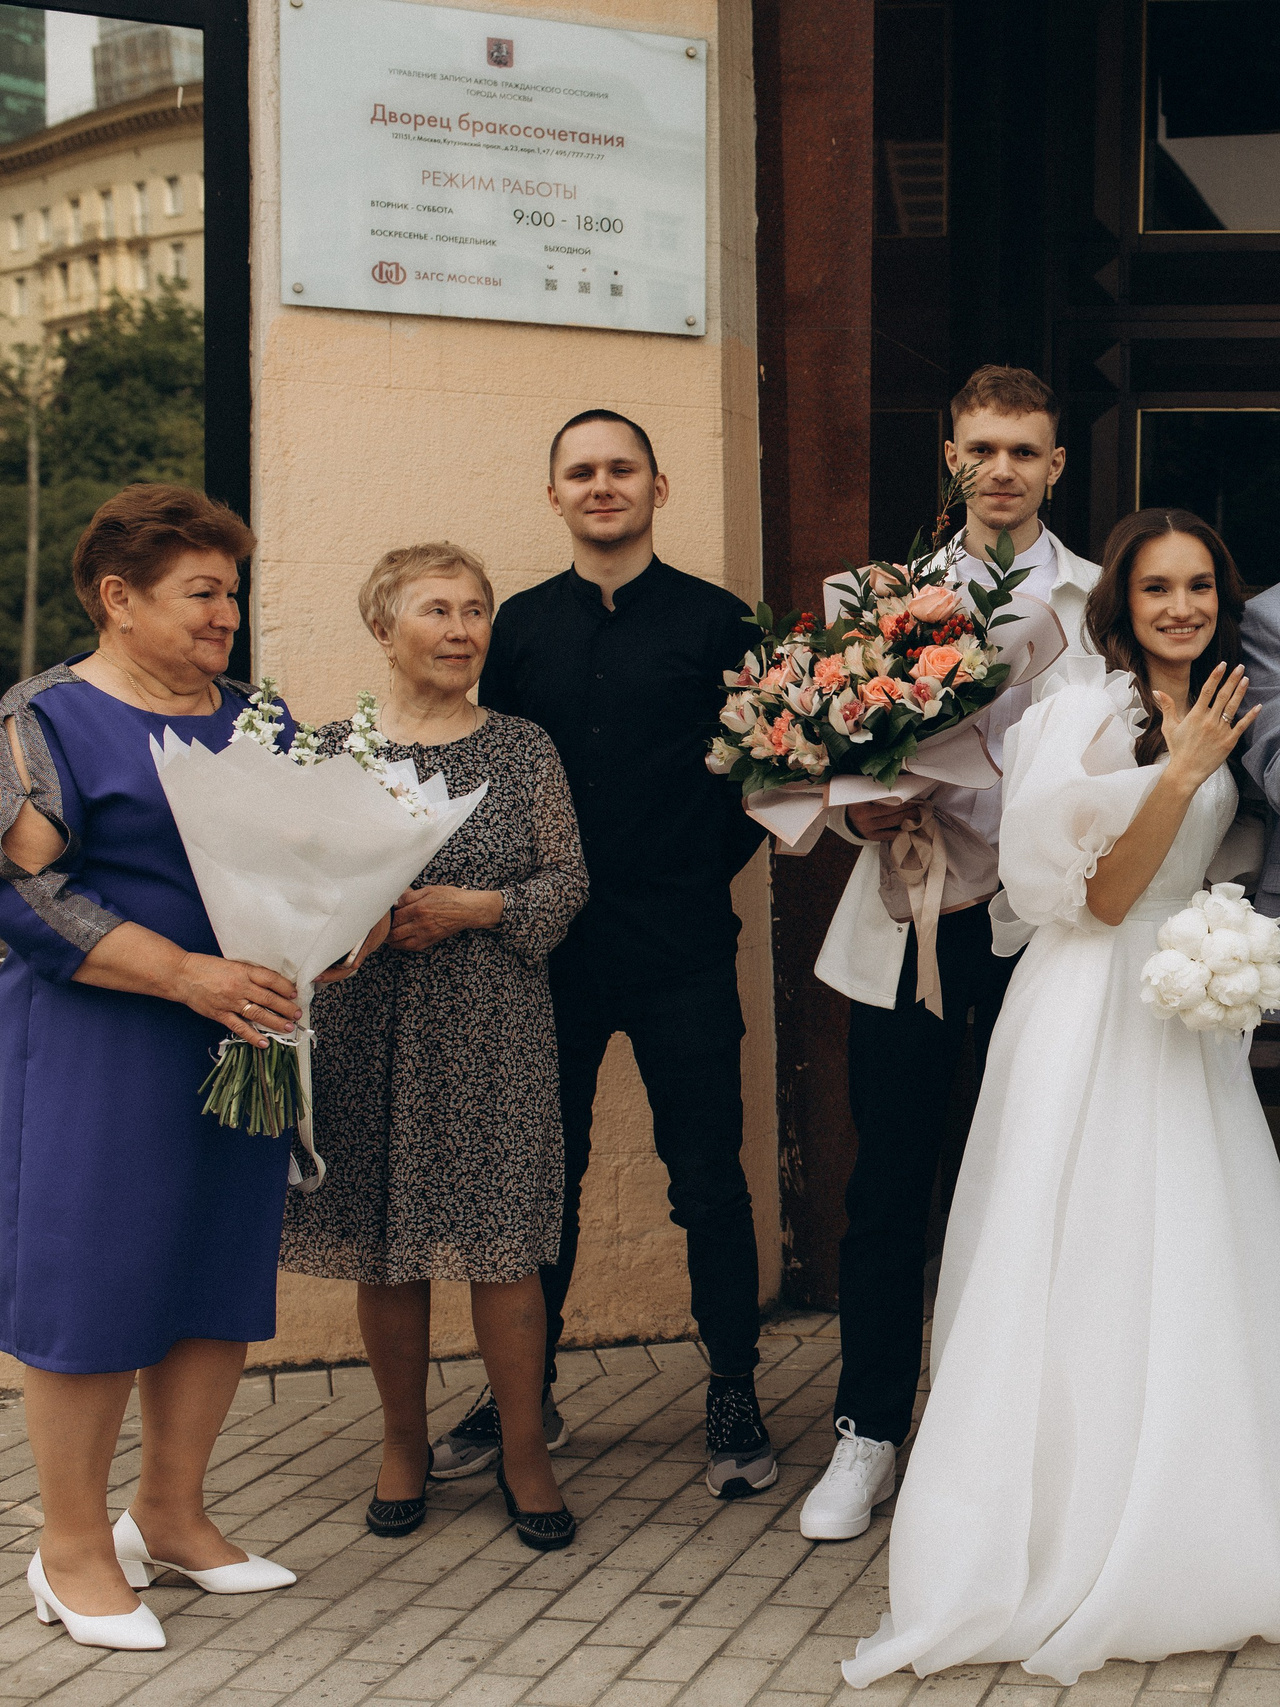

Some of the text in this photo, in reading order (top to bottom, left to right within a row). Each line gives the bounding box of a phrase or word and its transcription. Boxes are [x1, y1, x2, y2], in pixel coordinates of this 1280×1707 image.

[388, 68, 609, 99] УПРАВЛЕНИЕ ЗАПИСИ АКТОВ ГРАЖДАНСКОГО СОСТОЯНИЯ
[466, 88, 533, 102] ГОРОДА МОСКВЫ
[370, 103, 625, 148] Дворец бракосочетания
[421, 170, 577, 200] РЕЖИМ РАБОТЫ
[370, 200, 409, 211] ВТОРНИК
[416, 203, 454, 215] СУББОТА
[513, 208, 555, 228] 9:00
[576, 214, 624, 234] 18:00
[370, 228, 429, 241] ВОСКРЕСЕНЬЕ
[435, 234, 497, 247] ПОНЕДЕЛЬНИК
[543, 244, 591, 255] ВЫХОДНОЙ
[414, 270, 502, 287] ЗАГС МОСКВЫ
